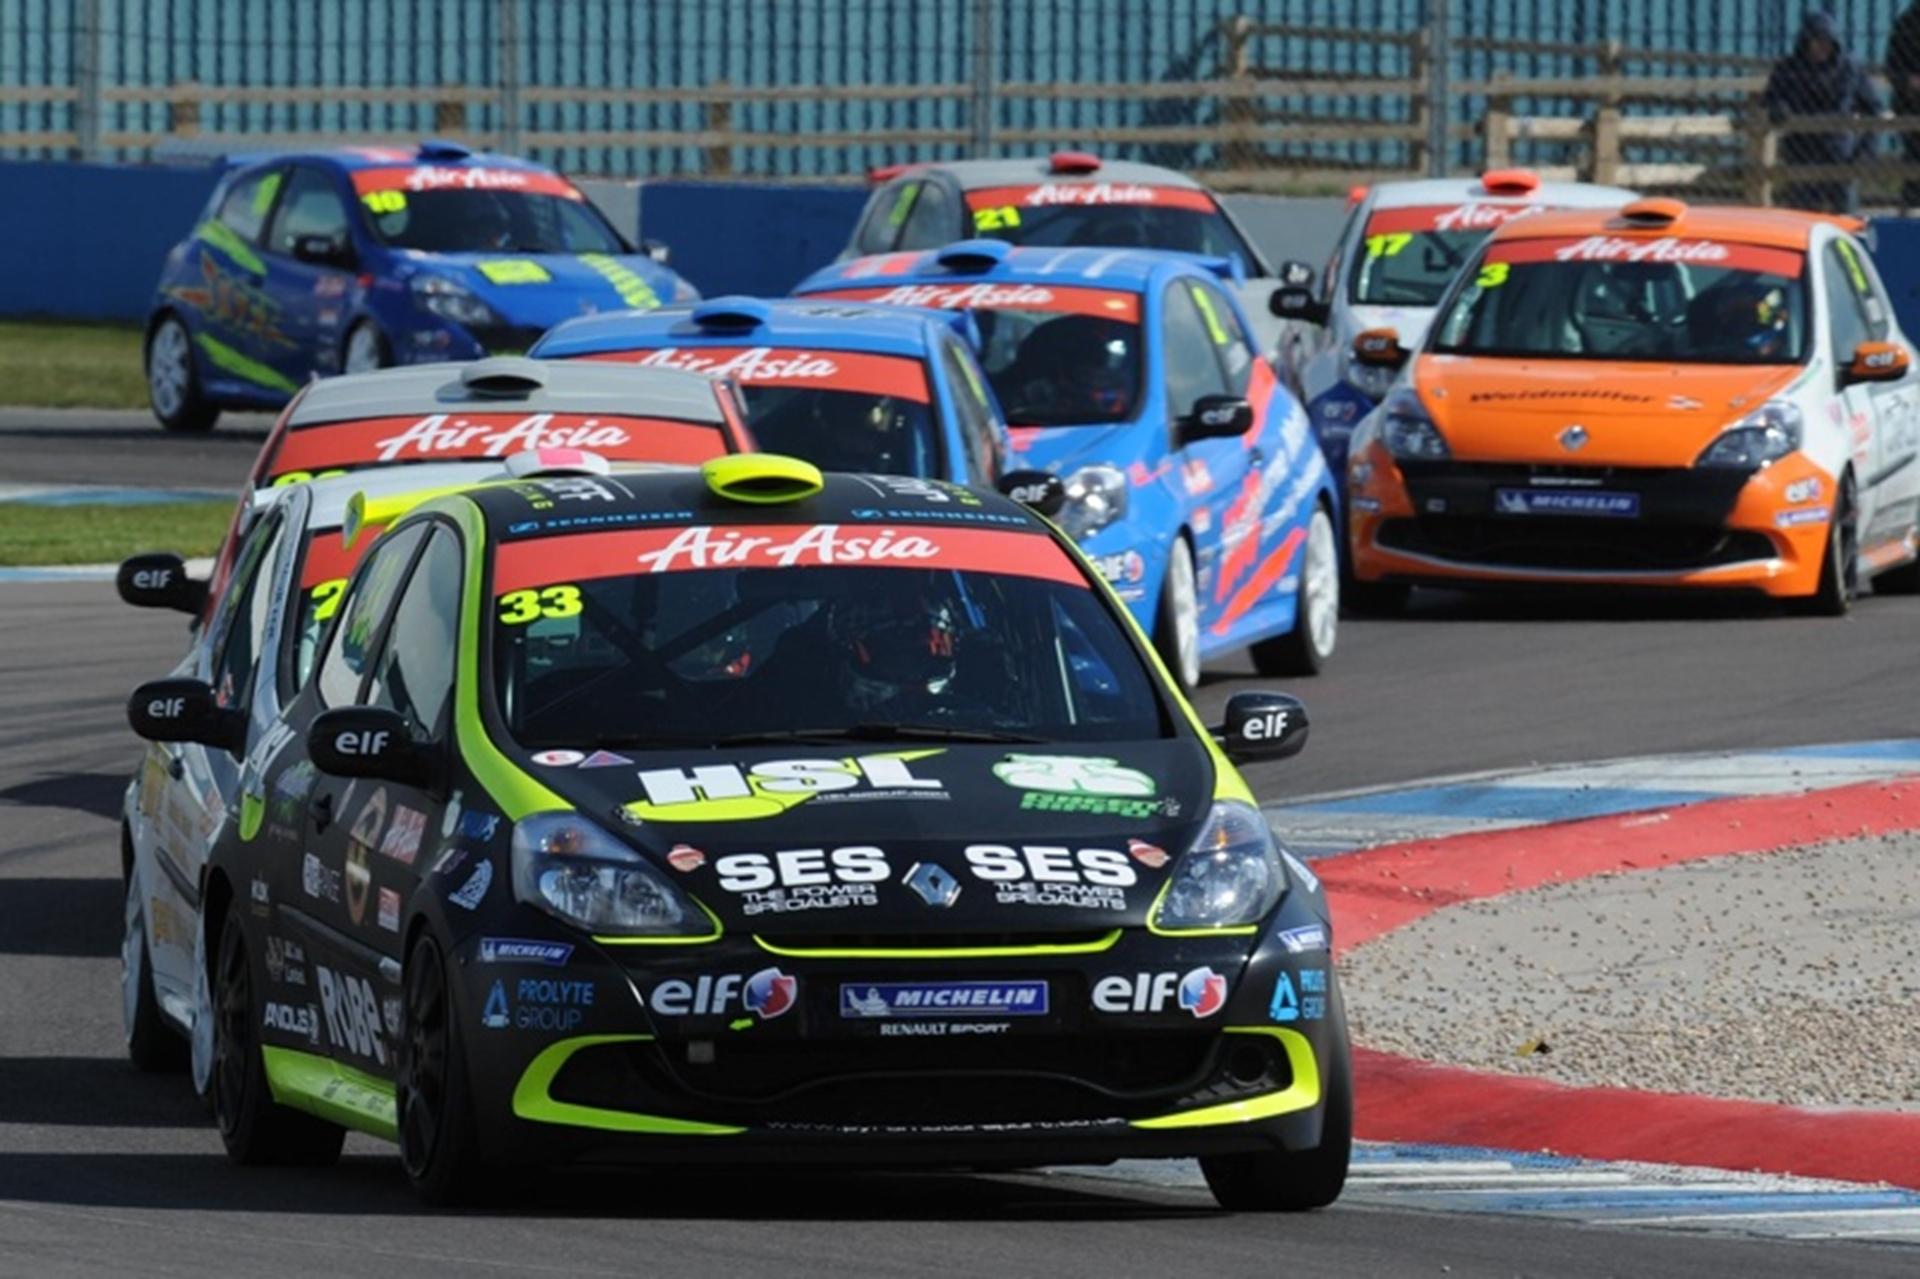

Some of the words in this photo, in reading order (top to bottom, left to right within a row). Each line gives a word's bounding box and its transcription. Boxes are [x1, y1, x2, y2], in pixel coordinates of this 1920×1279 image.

[974, 206, 1020, 231] 21
[1366, 233, 1413, 257] 17
[1476, 262, 1510, 287] 3
[133, 570, 173, 588] elf
[500, 586, 582, 624] 33
[148, 698, 185, 718] elf
[1242, 711, 1289, 741] elf
[335, 731, 391, 756] elf
[636, 757, 944, 806] HSL
[715, 846, 891, 892] SES
[964, 845, 1138, 887] SES
[741, 888, 785, 903] THE
[791, 883, 876, 897] POWER
[995, 881, 1038, 894] THE
[1043, 884, 1125, 898] POWER
[995, 891, 1127, 911] SPECIALISTS
[742, 893, 879, 916] SPECIALISTS
[498, 944, 567, 959] MICHELIN
[517, 979, 594, 1005] PROLYTE
[650, 974, 743, 1015] elf
[894, 988, 1038, 1007] MICHELIN
[1091, 970, 1179, 1013] elf
[515, 1006, 583, 1031] GROUP
[879, 1023, 946, 1036] RENAULT
[949, 1023, 1011, 1034] SPORT
